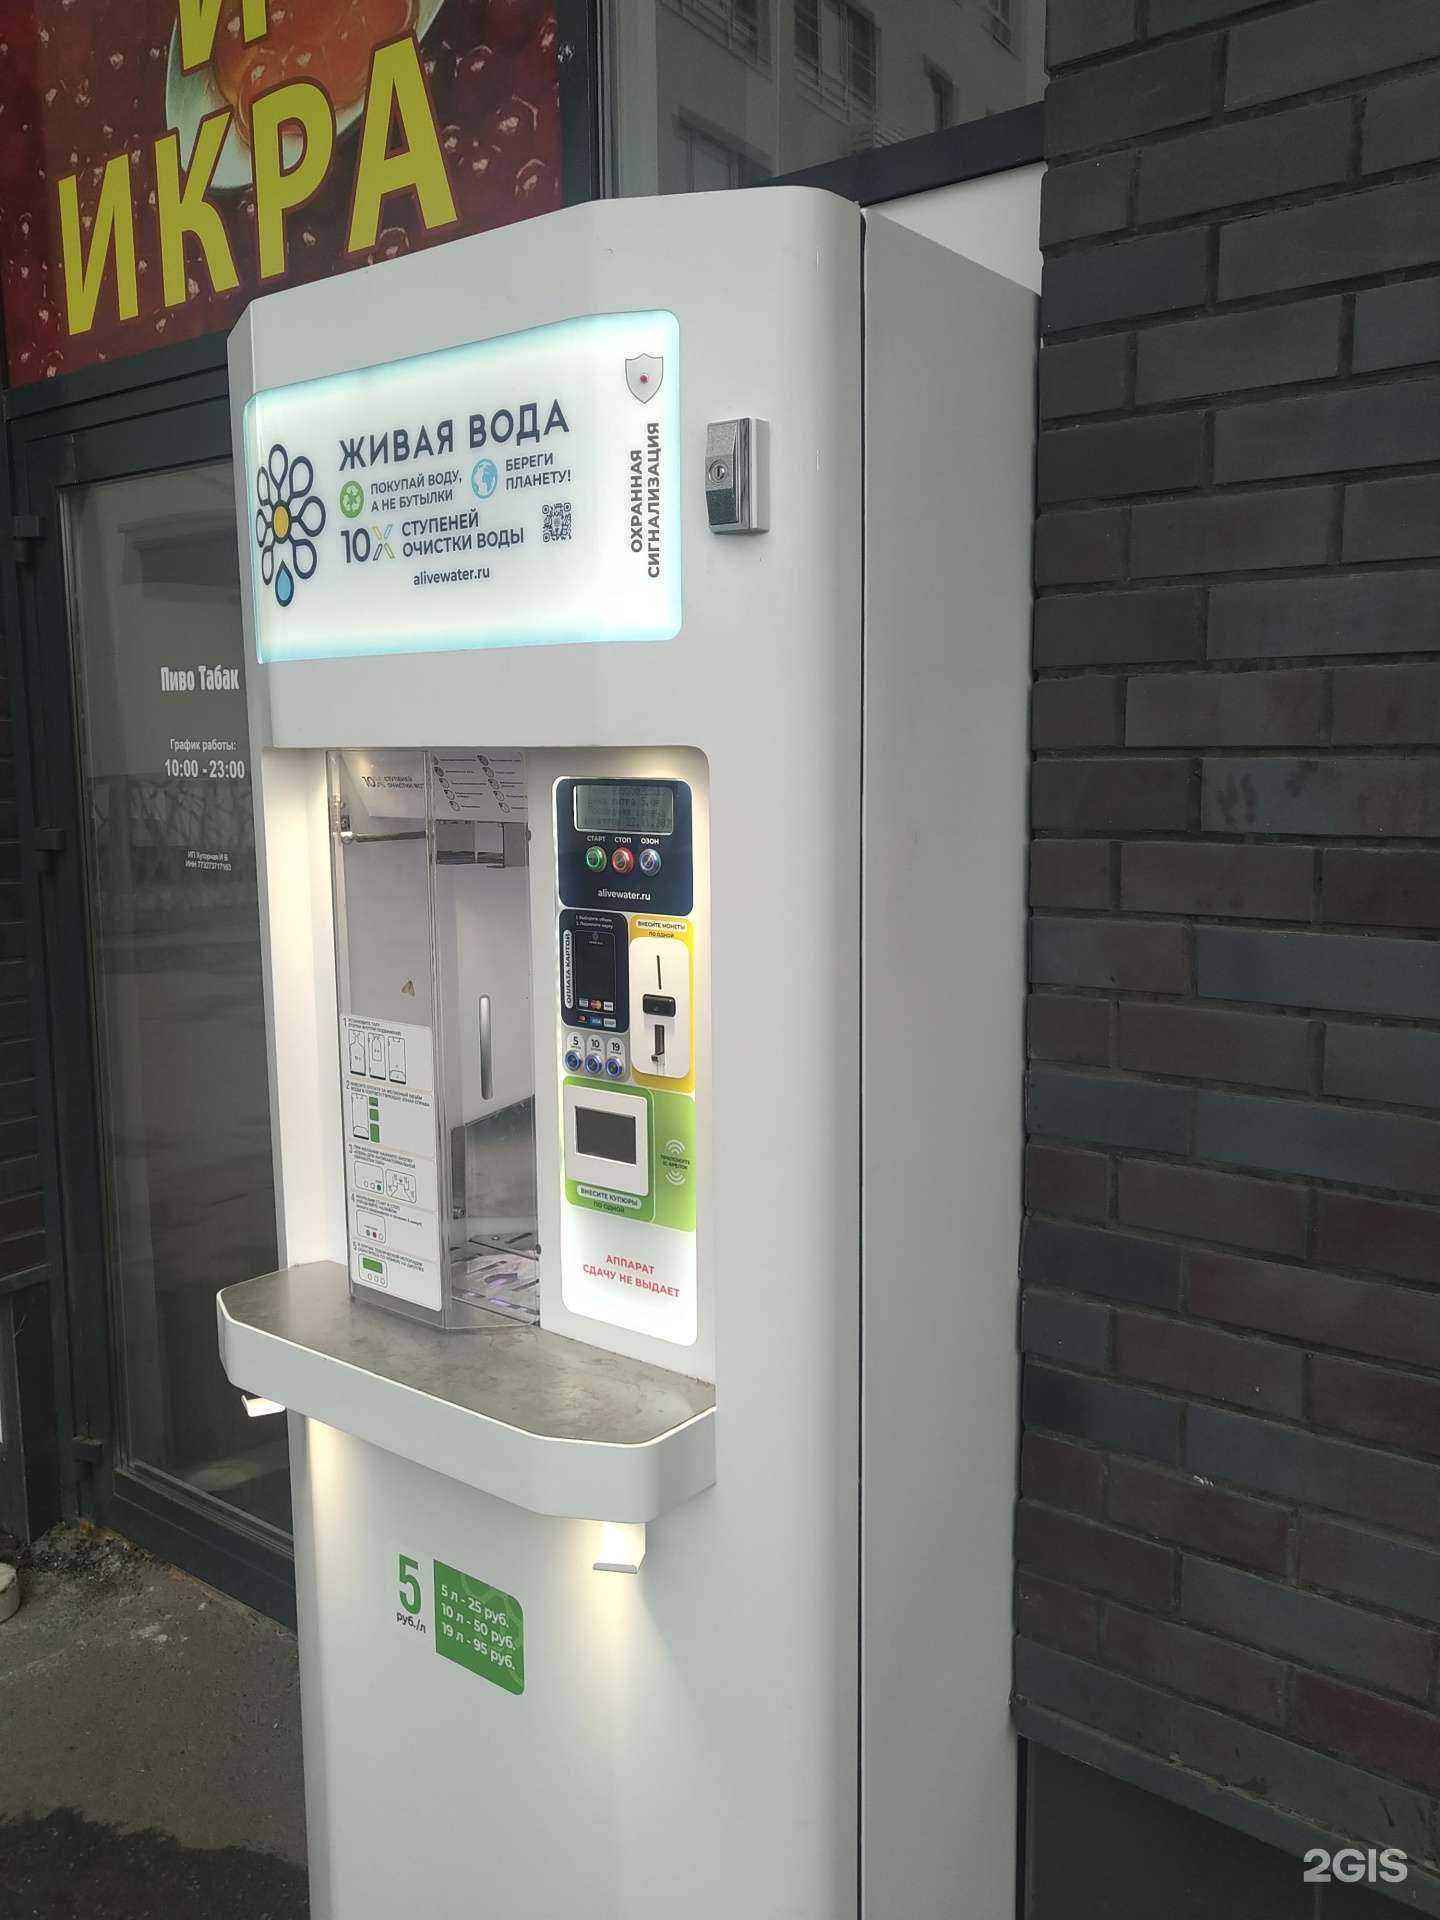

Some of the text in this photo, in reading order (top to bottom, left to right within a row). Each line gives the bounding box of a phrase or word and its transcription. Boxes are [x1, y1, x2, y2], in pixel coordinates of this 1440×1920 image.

[58, 37, 457, 336] ИКРА
[338, 398, 570, 471] ЖИВАЯ ВОДА
[505, 452, 554, 472] БЕРЕГИ
[370, 468, 462, 495] ПОКУПАЙ ВОДУ,
[505, 469, 571, 490] ПЛАНЕТУ!
[371, 489, 453, 513] А НЕ БУТЫЛКИ
[630, 450, 643, 553] ОХРАННАЯ
[647, 422, 661, 578] СИГНАЛИЗАЦИЯ
[401, 508, 479, 537] СТУПЕНЕЙ
[402, 527, 524, 557] ОЧИСТКИ ВОДЫ
[413, 567, 490, 586] alivewater.ru
[160, 664, 240, 691] Пиво Табак
[170, 738, 237, 752] График работы:
[164, 758, 199, 778] 10:00
[209, 760, 245, 779] 23:00
[614, 836, 632, 844] СТОП
[641, 837, 660, 845] ОЗОН
[598, 888, 651, 901] alivewater.ru
[573, 1036, 579, 1046] 5
[591, 1039, 600, 1048] 10
[612, 1042, 620, 1051] 19
[580, 1187, 638, 1206] ВНЕСИТЕ КУПЮРЫ
[593, 1201, 602, 1209] ПО
[606, 1254, 655, 1275] АППАРАТ
[582, 1264, 680, 1298] СДАЧУ НЕ ВЫДАЕТ
[399, 1553, 422, 1615] 5
[441, 1584, 448, 1597] 5
[450, 1593, 458, 1602] л
[468, 1597, 482, 1613] 25
[484, 1608, 509, 1628] руб.
[396, 1612, 426, 1634] руб./л
[441, 1602, 453, 1617] 10
[456, 1613, 464, 1624] л
[473, 1619, 488, 1636] 50
[491, 1630, 516, 1651] руб.
[441, 1622, 454, 1637] 19
[456, 1634, 464, 1643] л
[473, 1638, 488, 1655] 95
[490, 1649, 516, 1670] руб.
